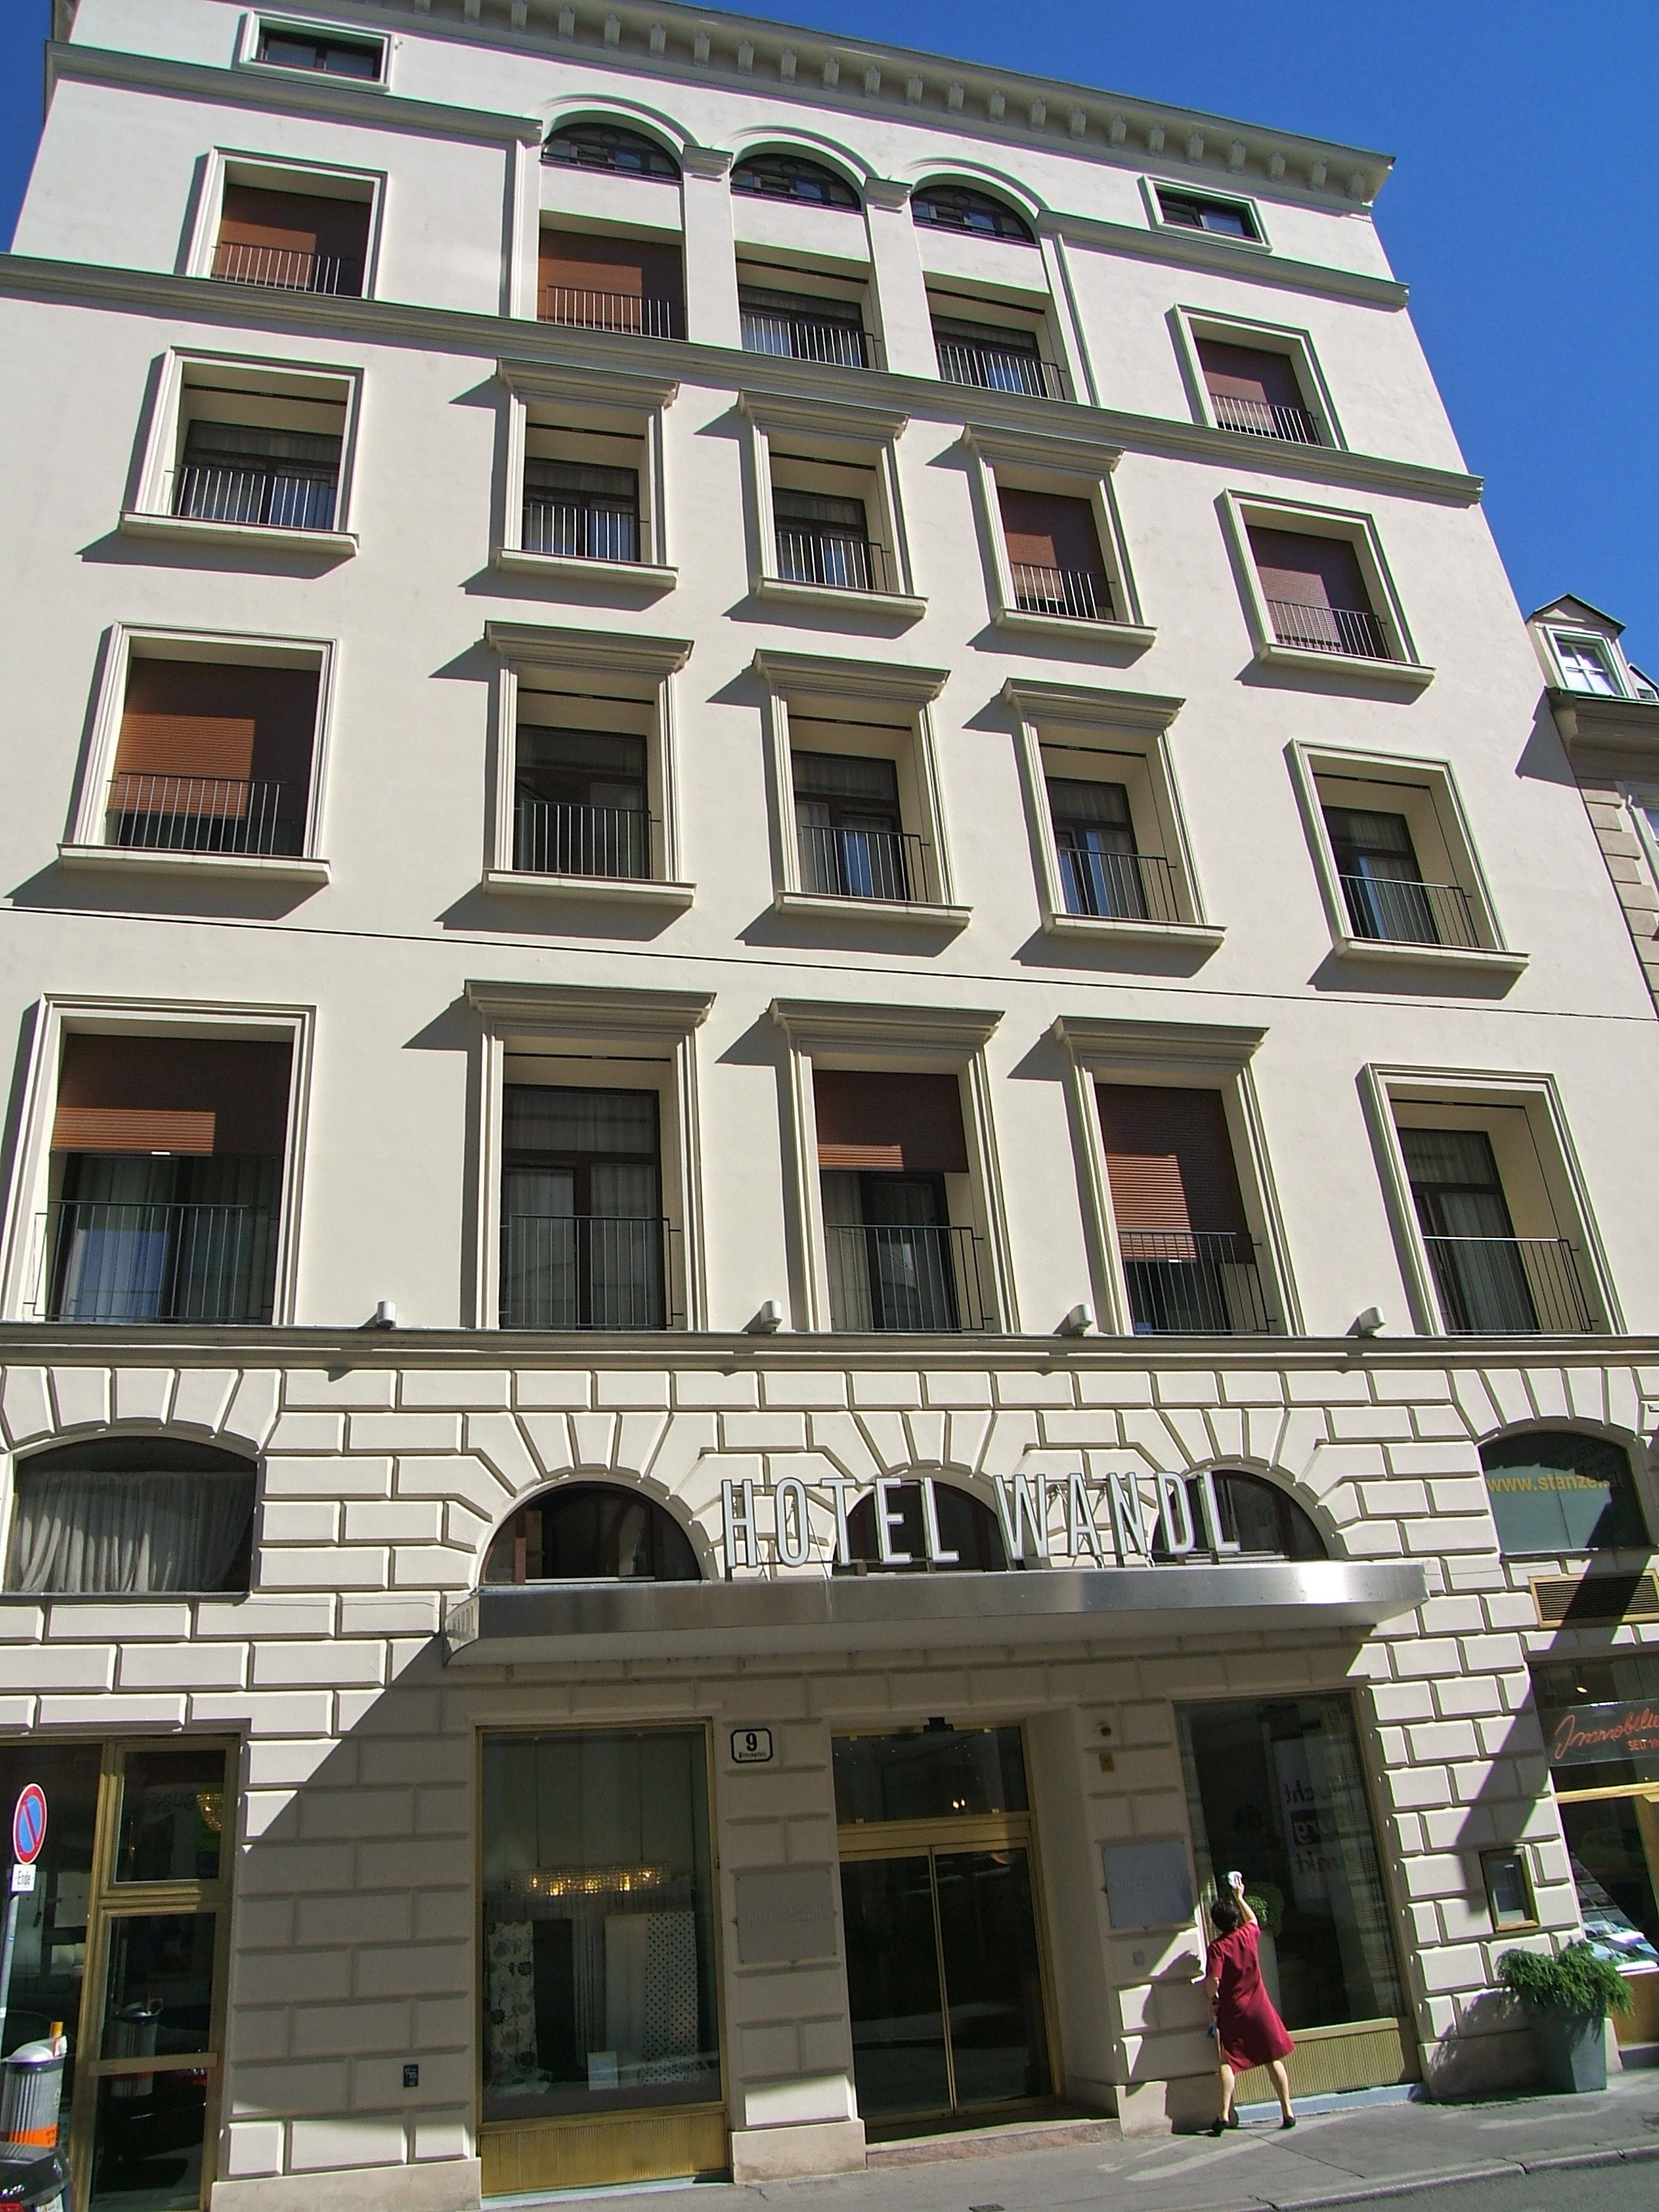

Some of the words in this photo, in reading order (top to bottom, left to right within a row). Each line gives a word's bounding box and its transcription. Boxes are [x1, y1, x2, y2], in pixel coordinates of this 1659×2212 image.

[722, 1476, 959, 1567] HOTEL
[992, 1471, 1240, 1560] WANDL
[746, 1733, 757, 1751] 9
[17, 1870, 30, 1885] Ende
